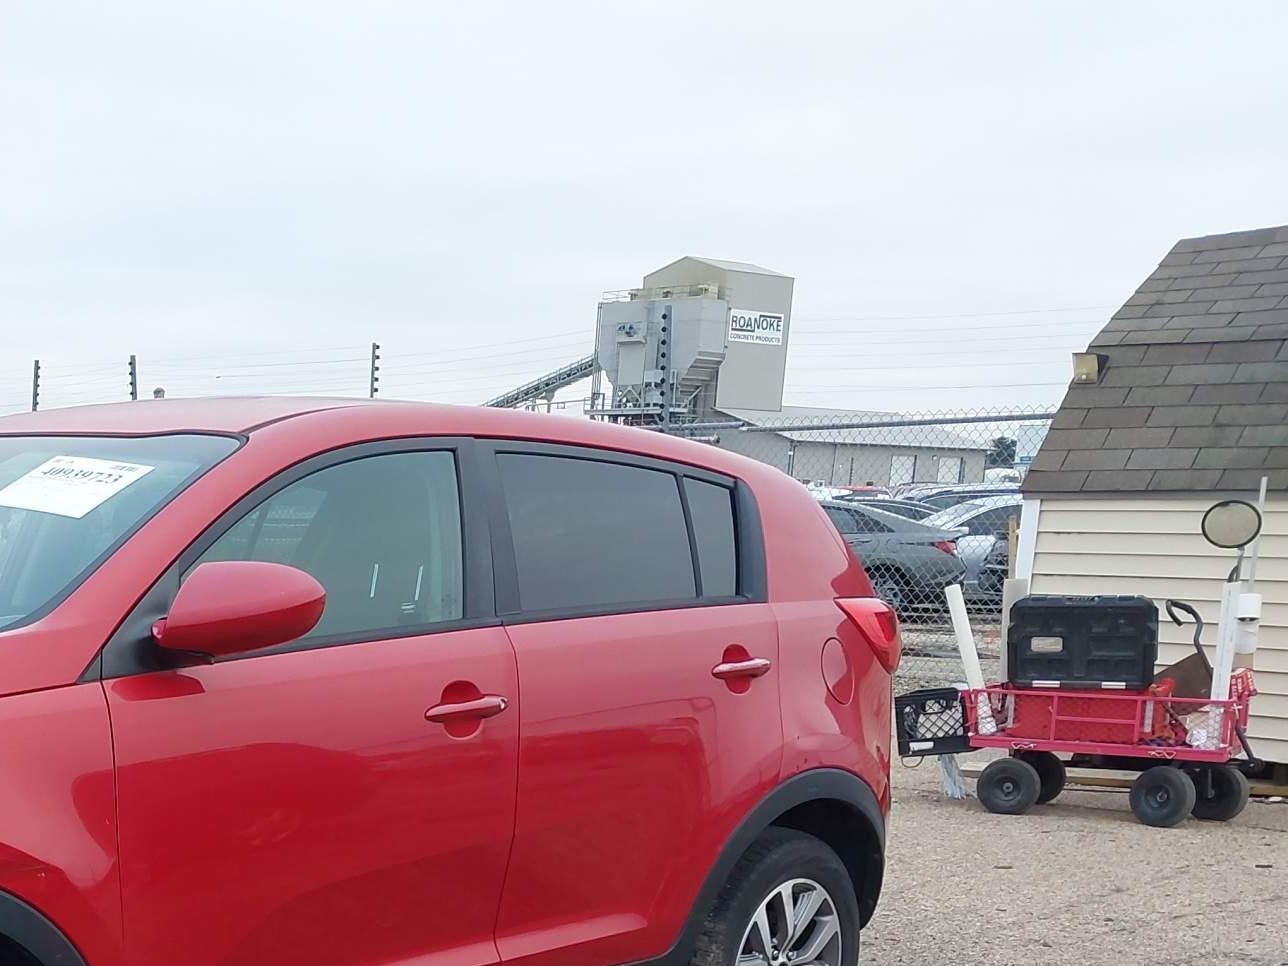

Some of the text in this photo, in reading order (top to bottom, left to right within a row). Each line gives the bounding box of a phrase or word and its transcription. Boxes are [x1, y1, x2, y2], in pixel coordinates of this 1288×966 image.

[731, 315, 782, 332] ROANOKE
[755, 335, 781, 344] PRODUCTS
[41, 467, 123, 484] 40939723
